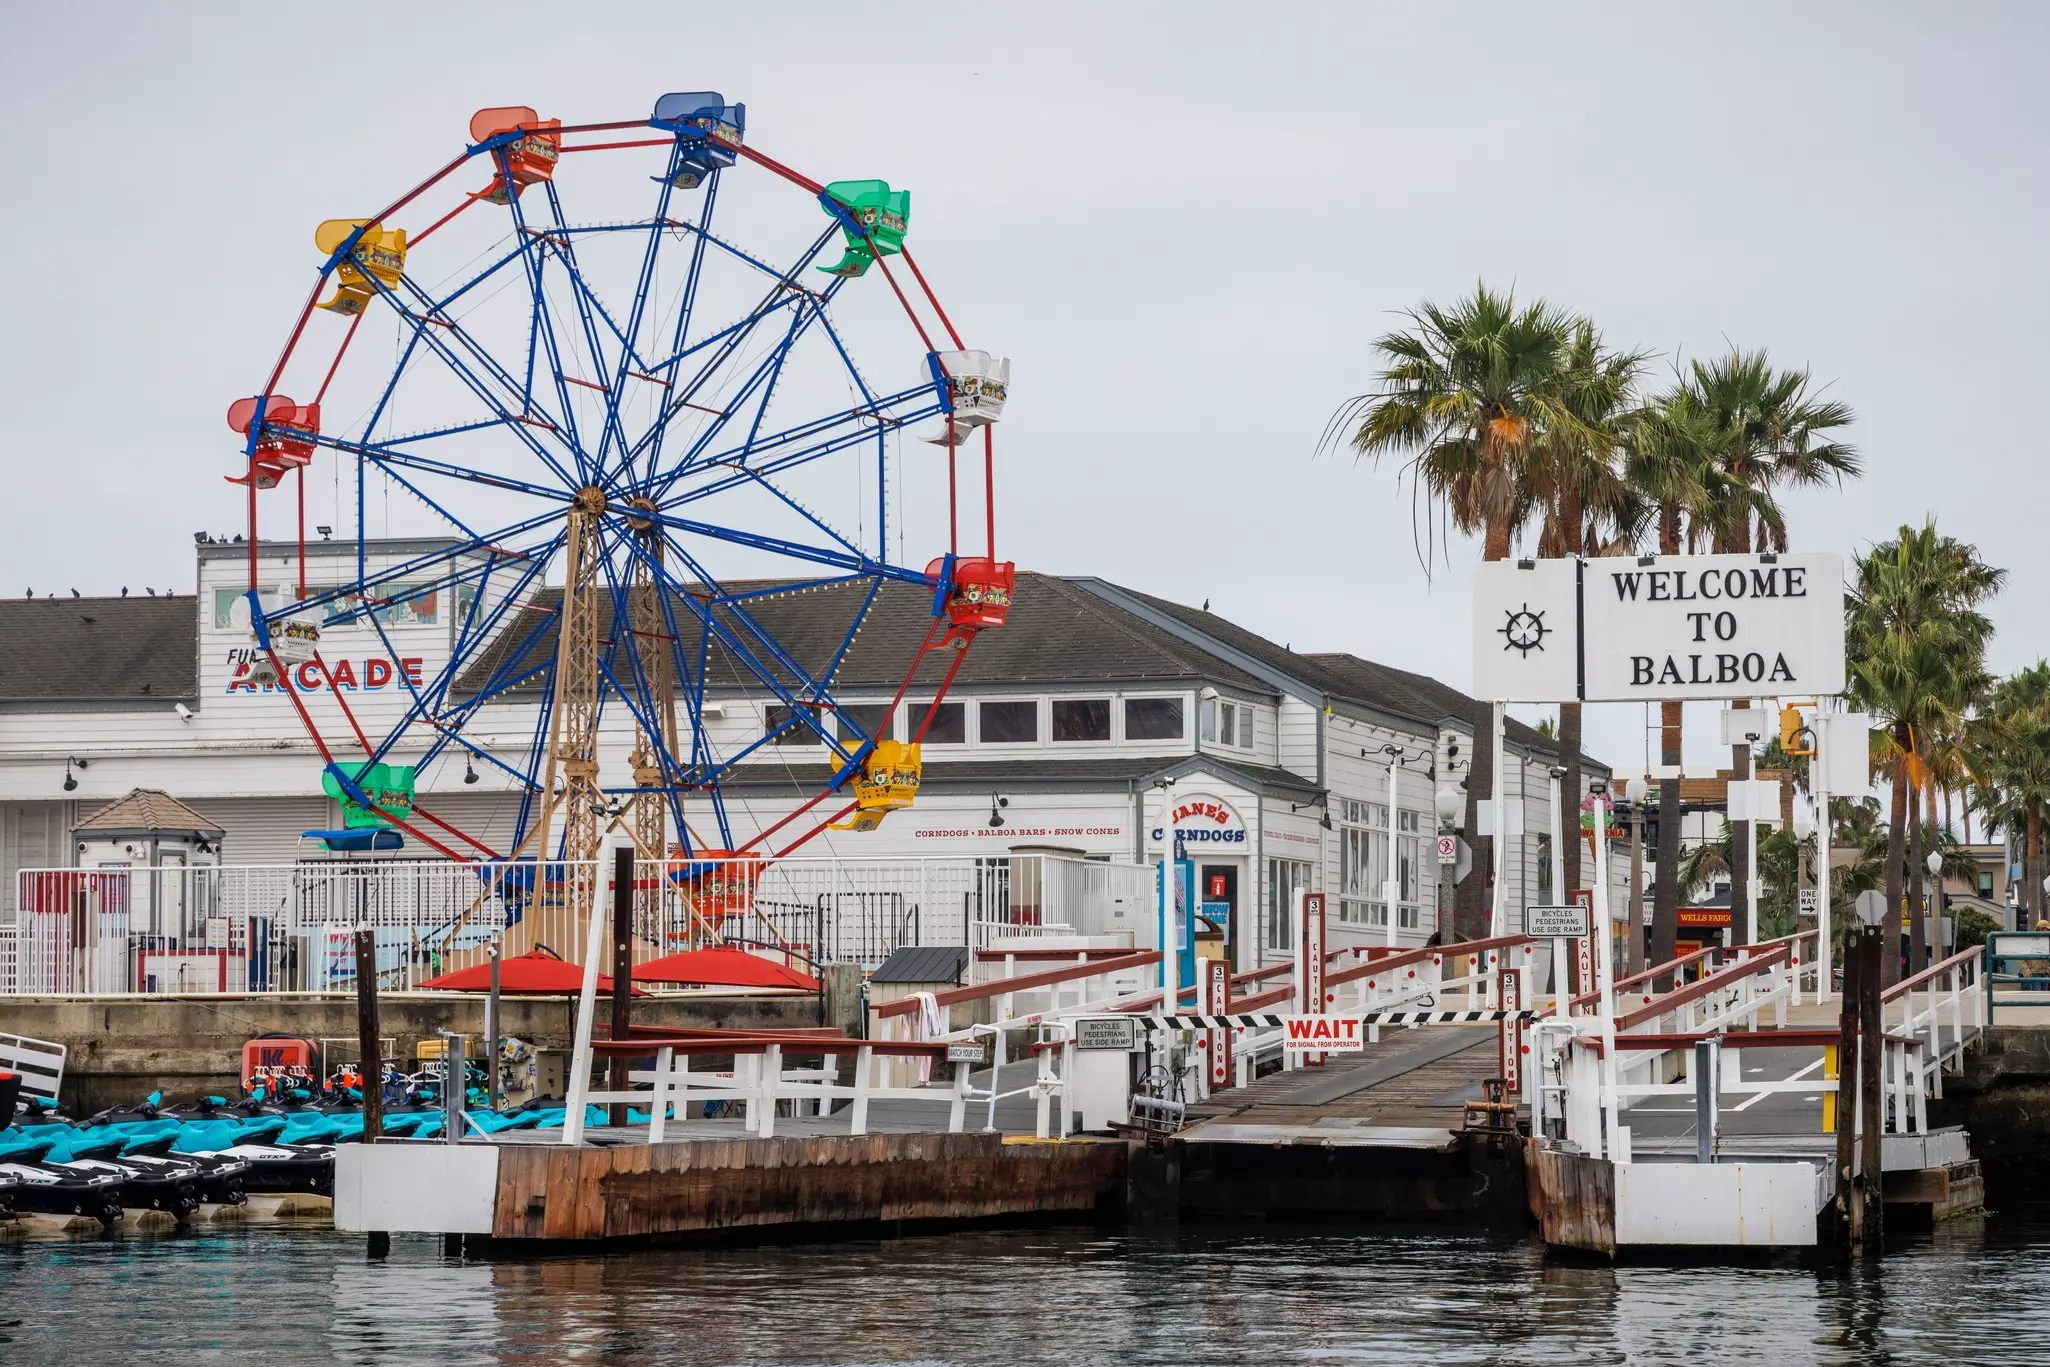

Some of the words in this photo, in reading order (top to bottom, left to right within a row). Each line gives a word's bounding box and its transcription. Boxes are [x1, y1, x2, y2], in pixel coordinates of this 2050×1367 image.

[1611, 567, 1807, 601] WELCOME
[1687, 611, 1737, 642] TO
[1630, 652, 1797, 685] BALBOA
[915, 829, 969, 838] CORNDOGS
[977, 829, 1017, 837] BALBOA
[1054, 828, 1083, 836] SNOW
[1152, 828, 1245, 843] CRNDOGS
[1311, 901, 1318, 909] 3
[1215, 967, 1222, 975] 3
[1505, 975, 1512, 983] 3
[1581, 939, 1590, 1015] CAUTIN
[1288, 1019, 1358, 1038] WAIT
[1506, 995, 1514, 1078] CUTION
[963, 1049, 973, 1057] YOUR
